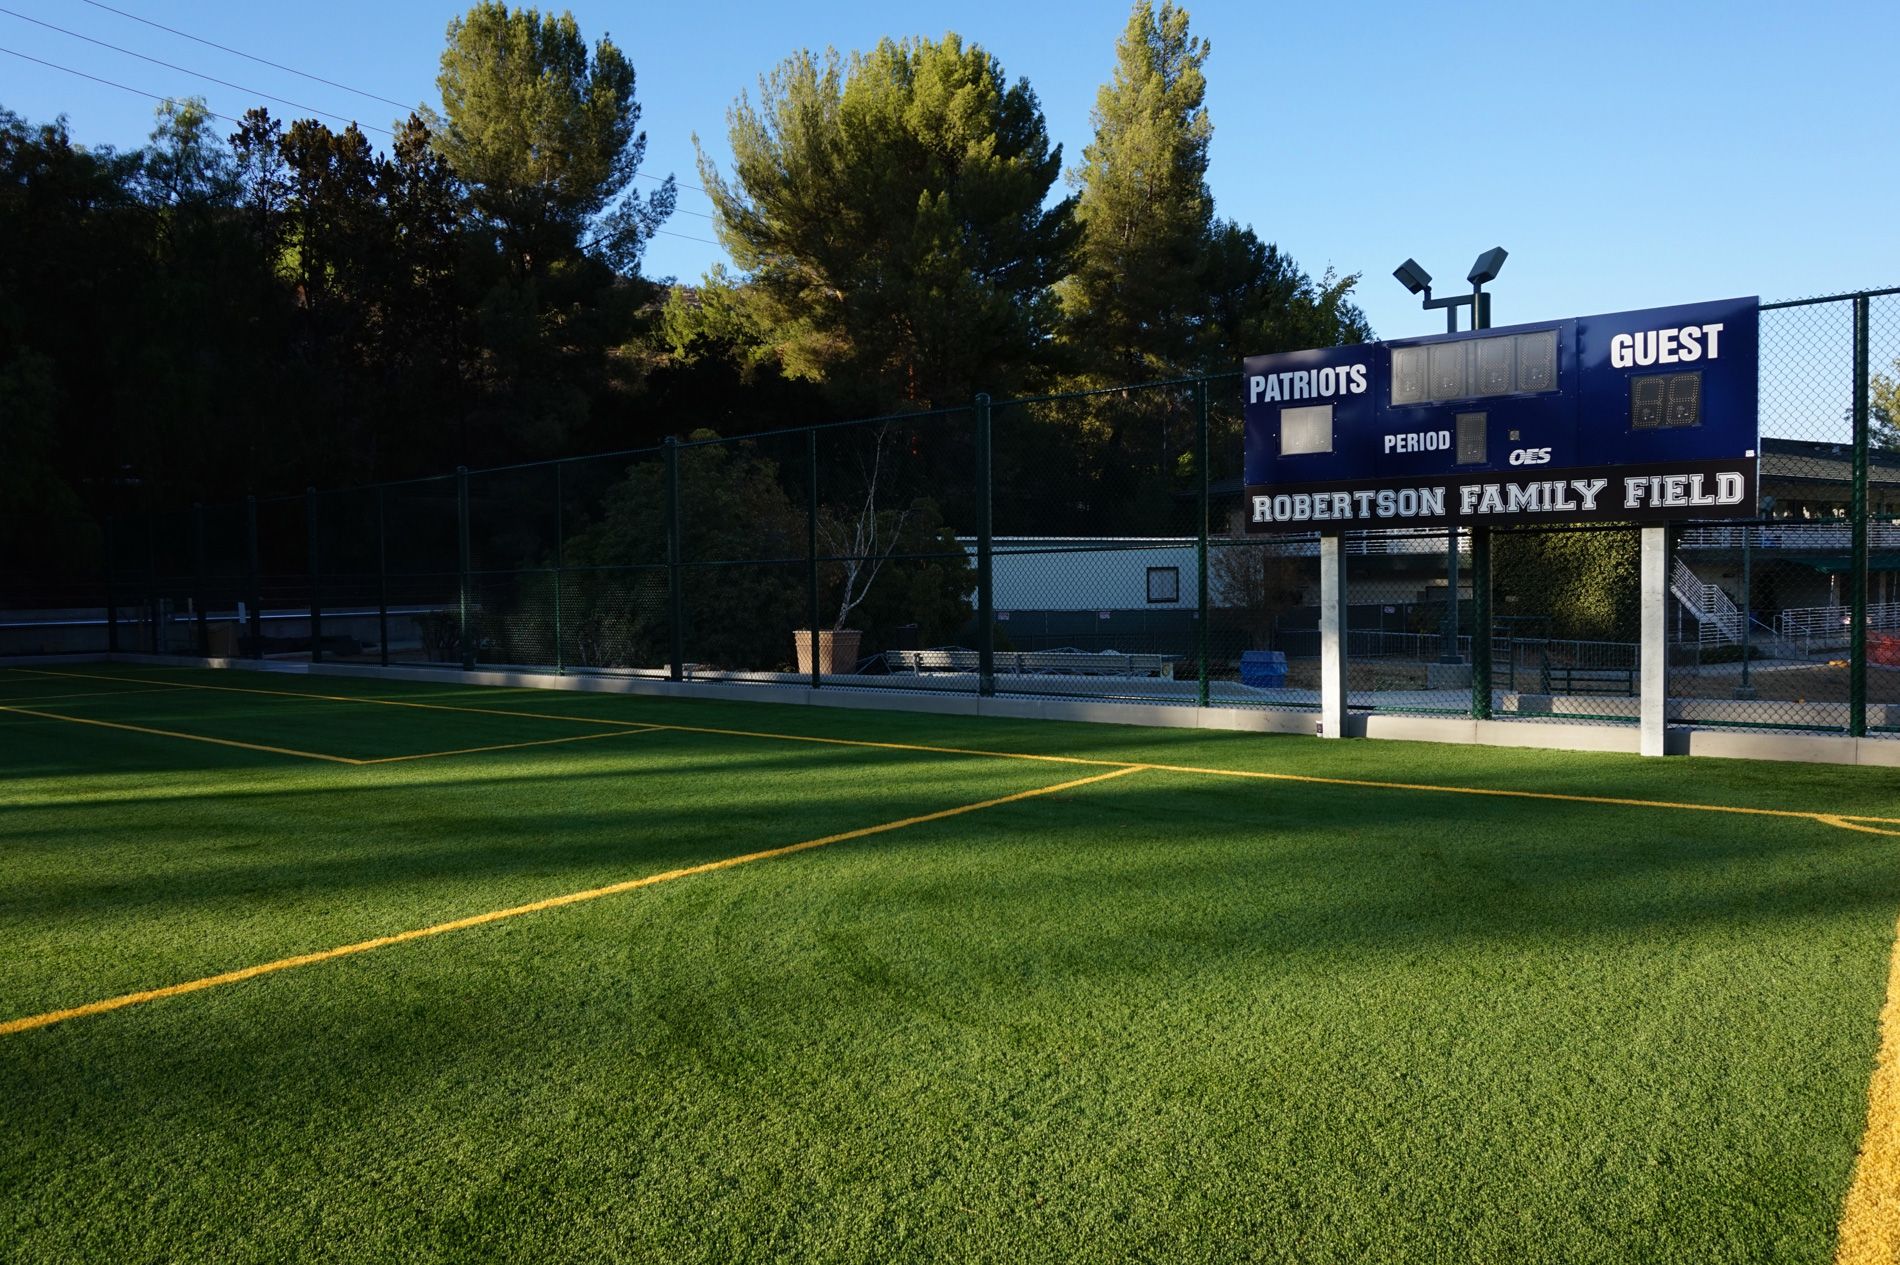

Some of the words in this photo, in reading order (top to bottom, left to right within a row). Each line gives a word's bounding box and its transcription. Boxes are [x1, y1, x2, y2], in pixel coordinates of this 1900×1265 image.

[1610, 322, 1724, 369] GUEST
[1250, 363, 1368, 404] PATRIOTS
[1384, 430, 1451, 454] PERIOD
[1509, 447, 1552, 466] OES
[1252, 486, 1447, 523] ROBERTSON
[1459, 478, 1608, 515] FAMILY
[1624, 471, 1745, 509] FIELD
